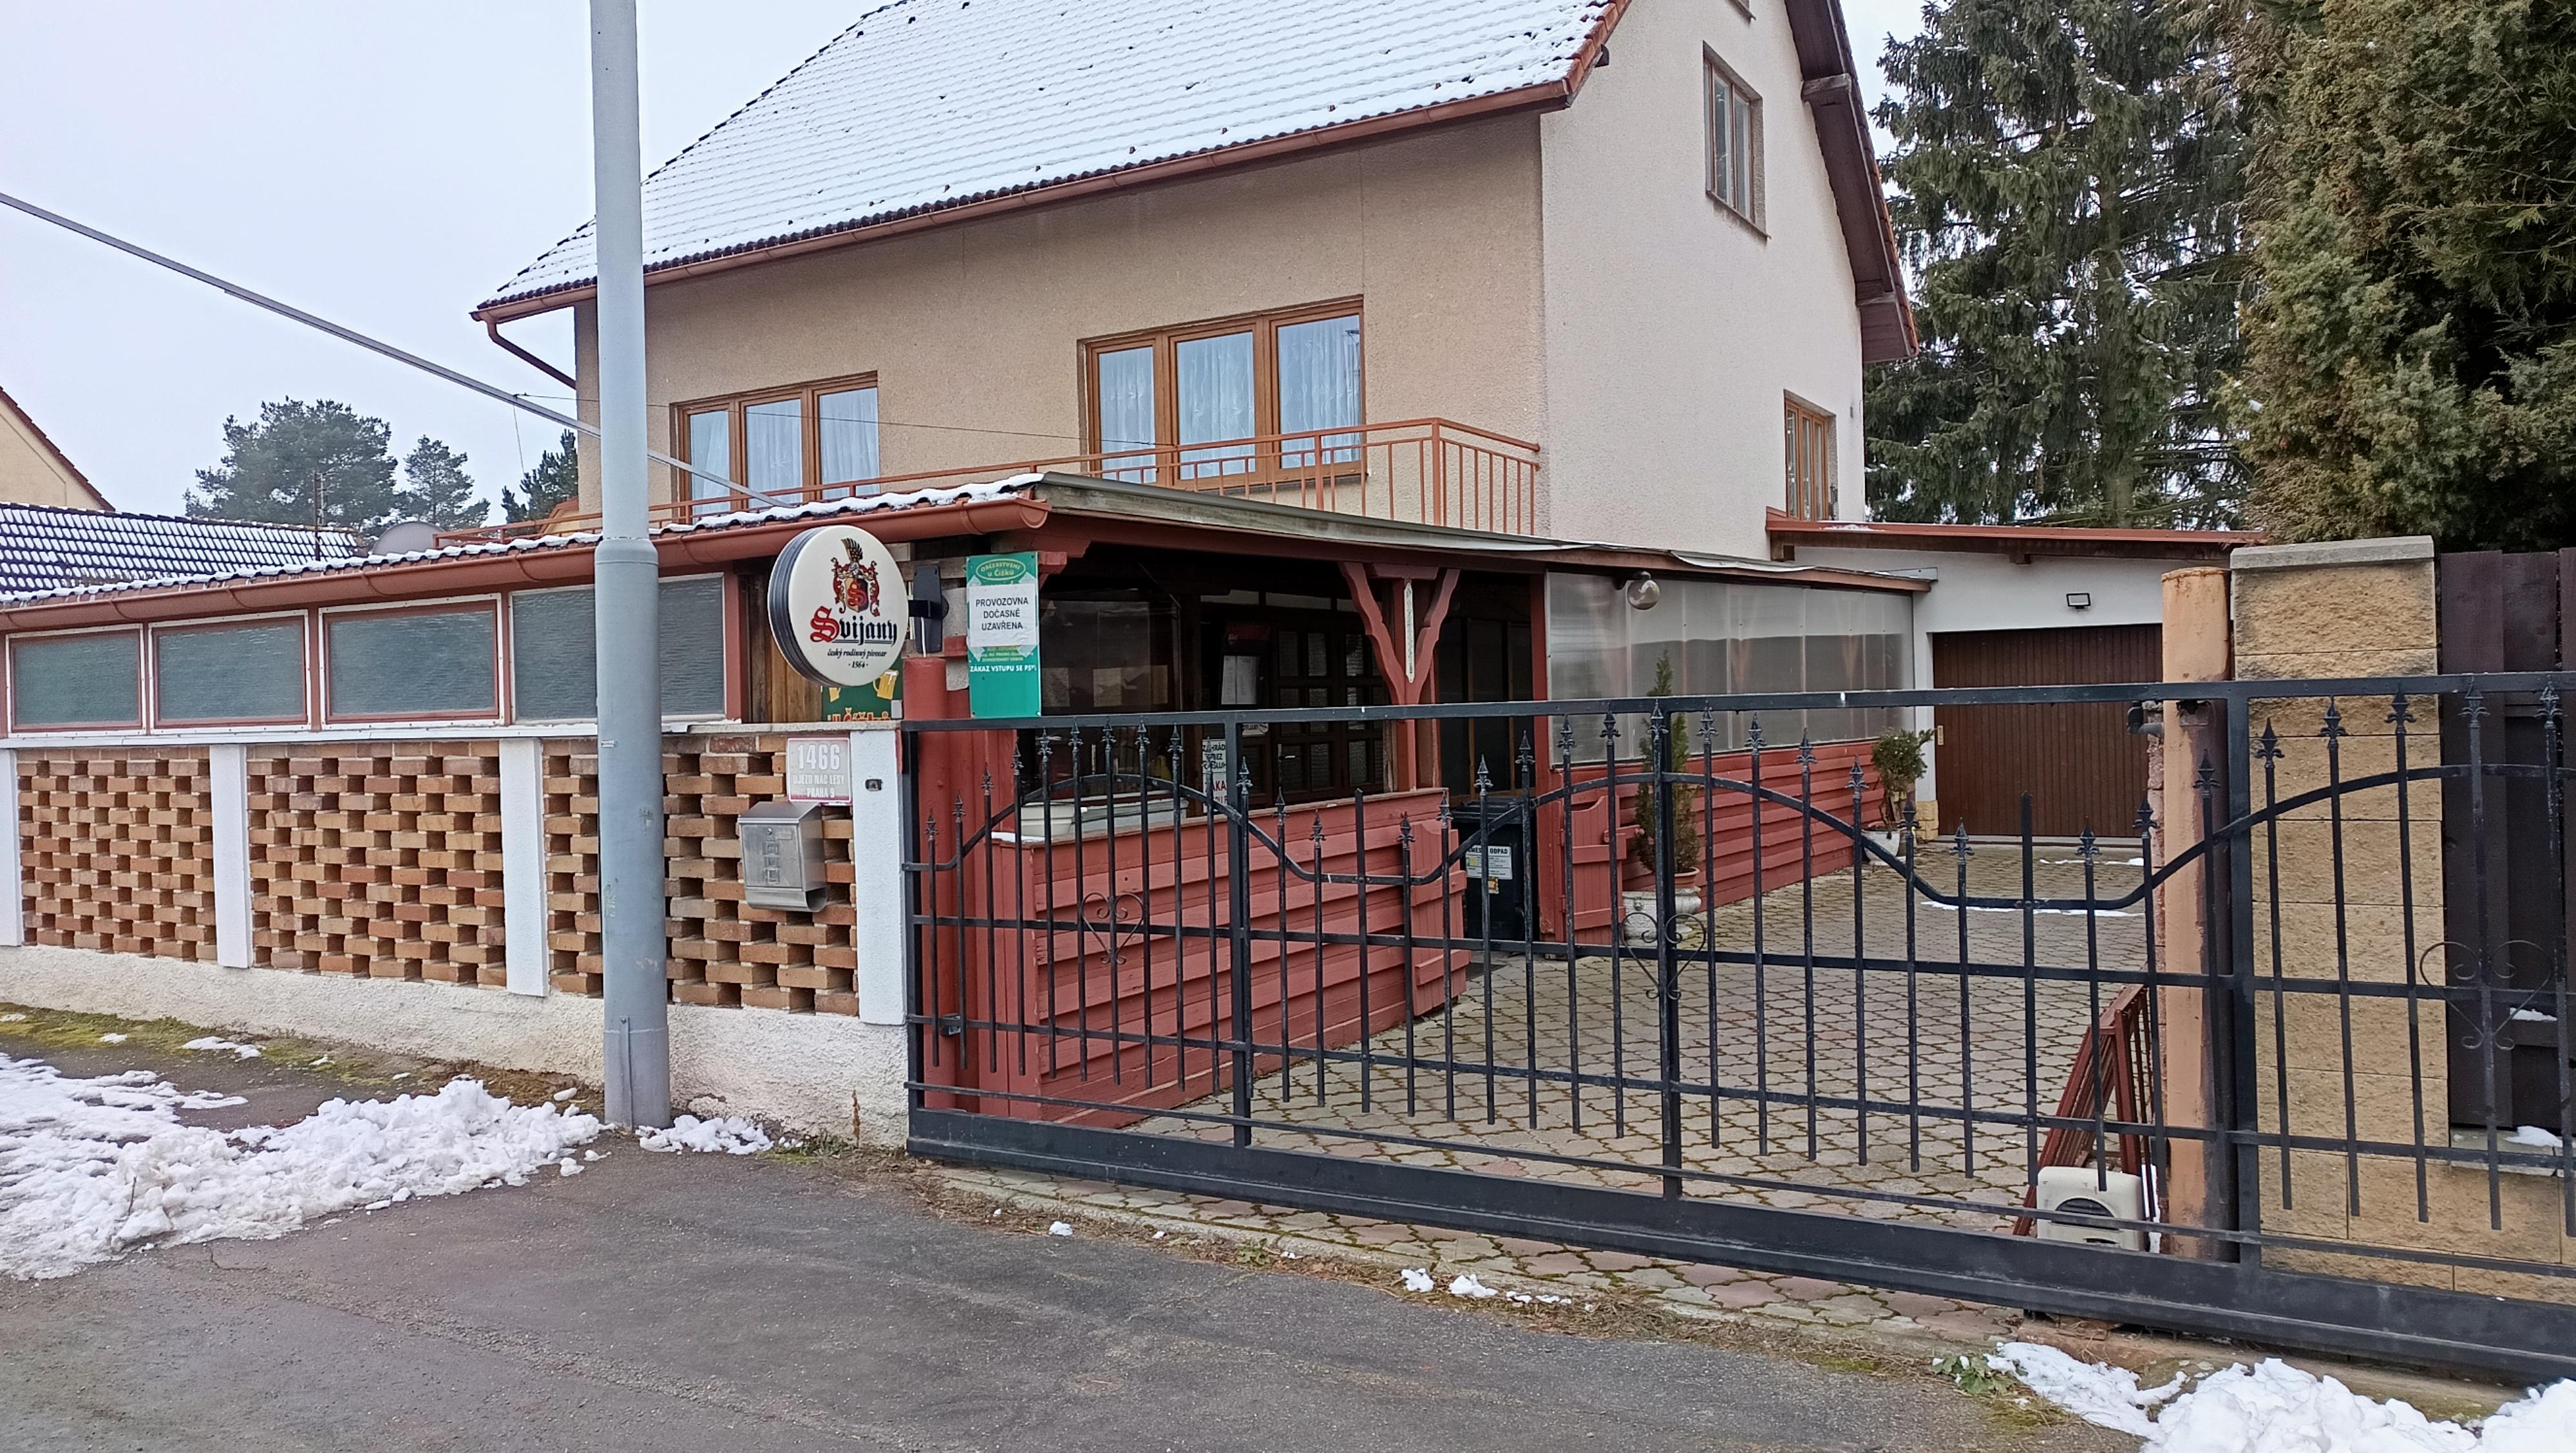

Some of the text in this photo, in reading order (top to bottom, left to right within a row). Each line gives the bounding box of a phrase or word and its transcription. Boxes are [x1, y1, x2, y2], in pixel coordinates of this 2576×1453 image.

[976, 597, 1029, 607] PROVOZOVNA
[983, 608, 1021, 619] DOČASNĚ
[810, 605, 898, 647] Svijany
[981, 620, 1023, 631] UZAVŘENA
[797, 744, 840, 770] 1466
[829, 774, 845, 784] LESY
[806, 787, 835, 798] PRAHA 9
